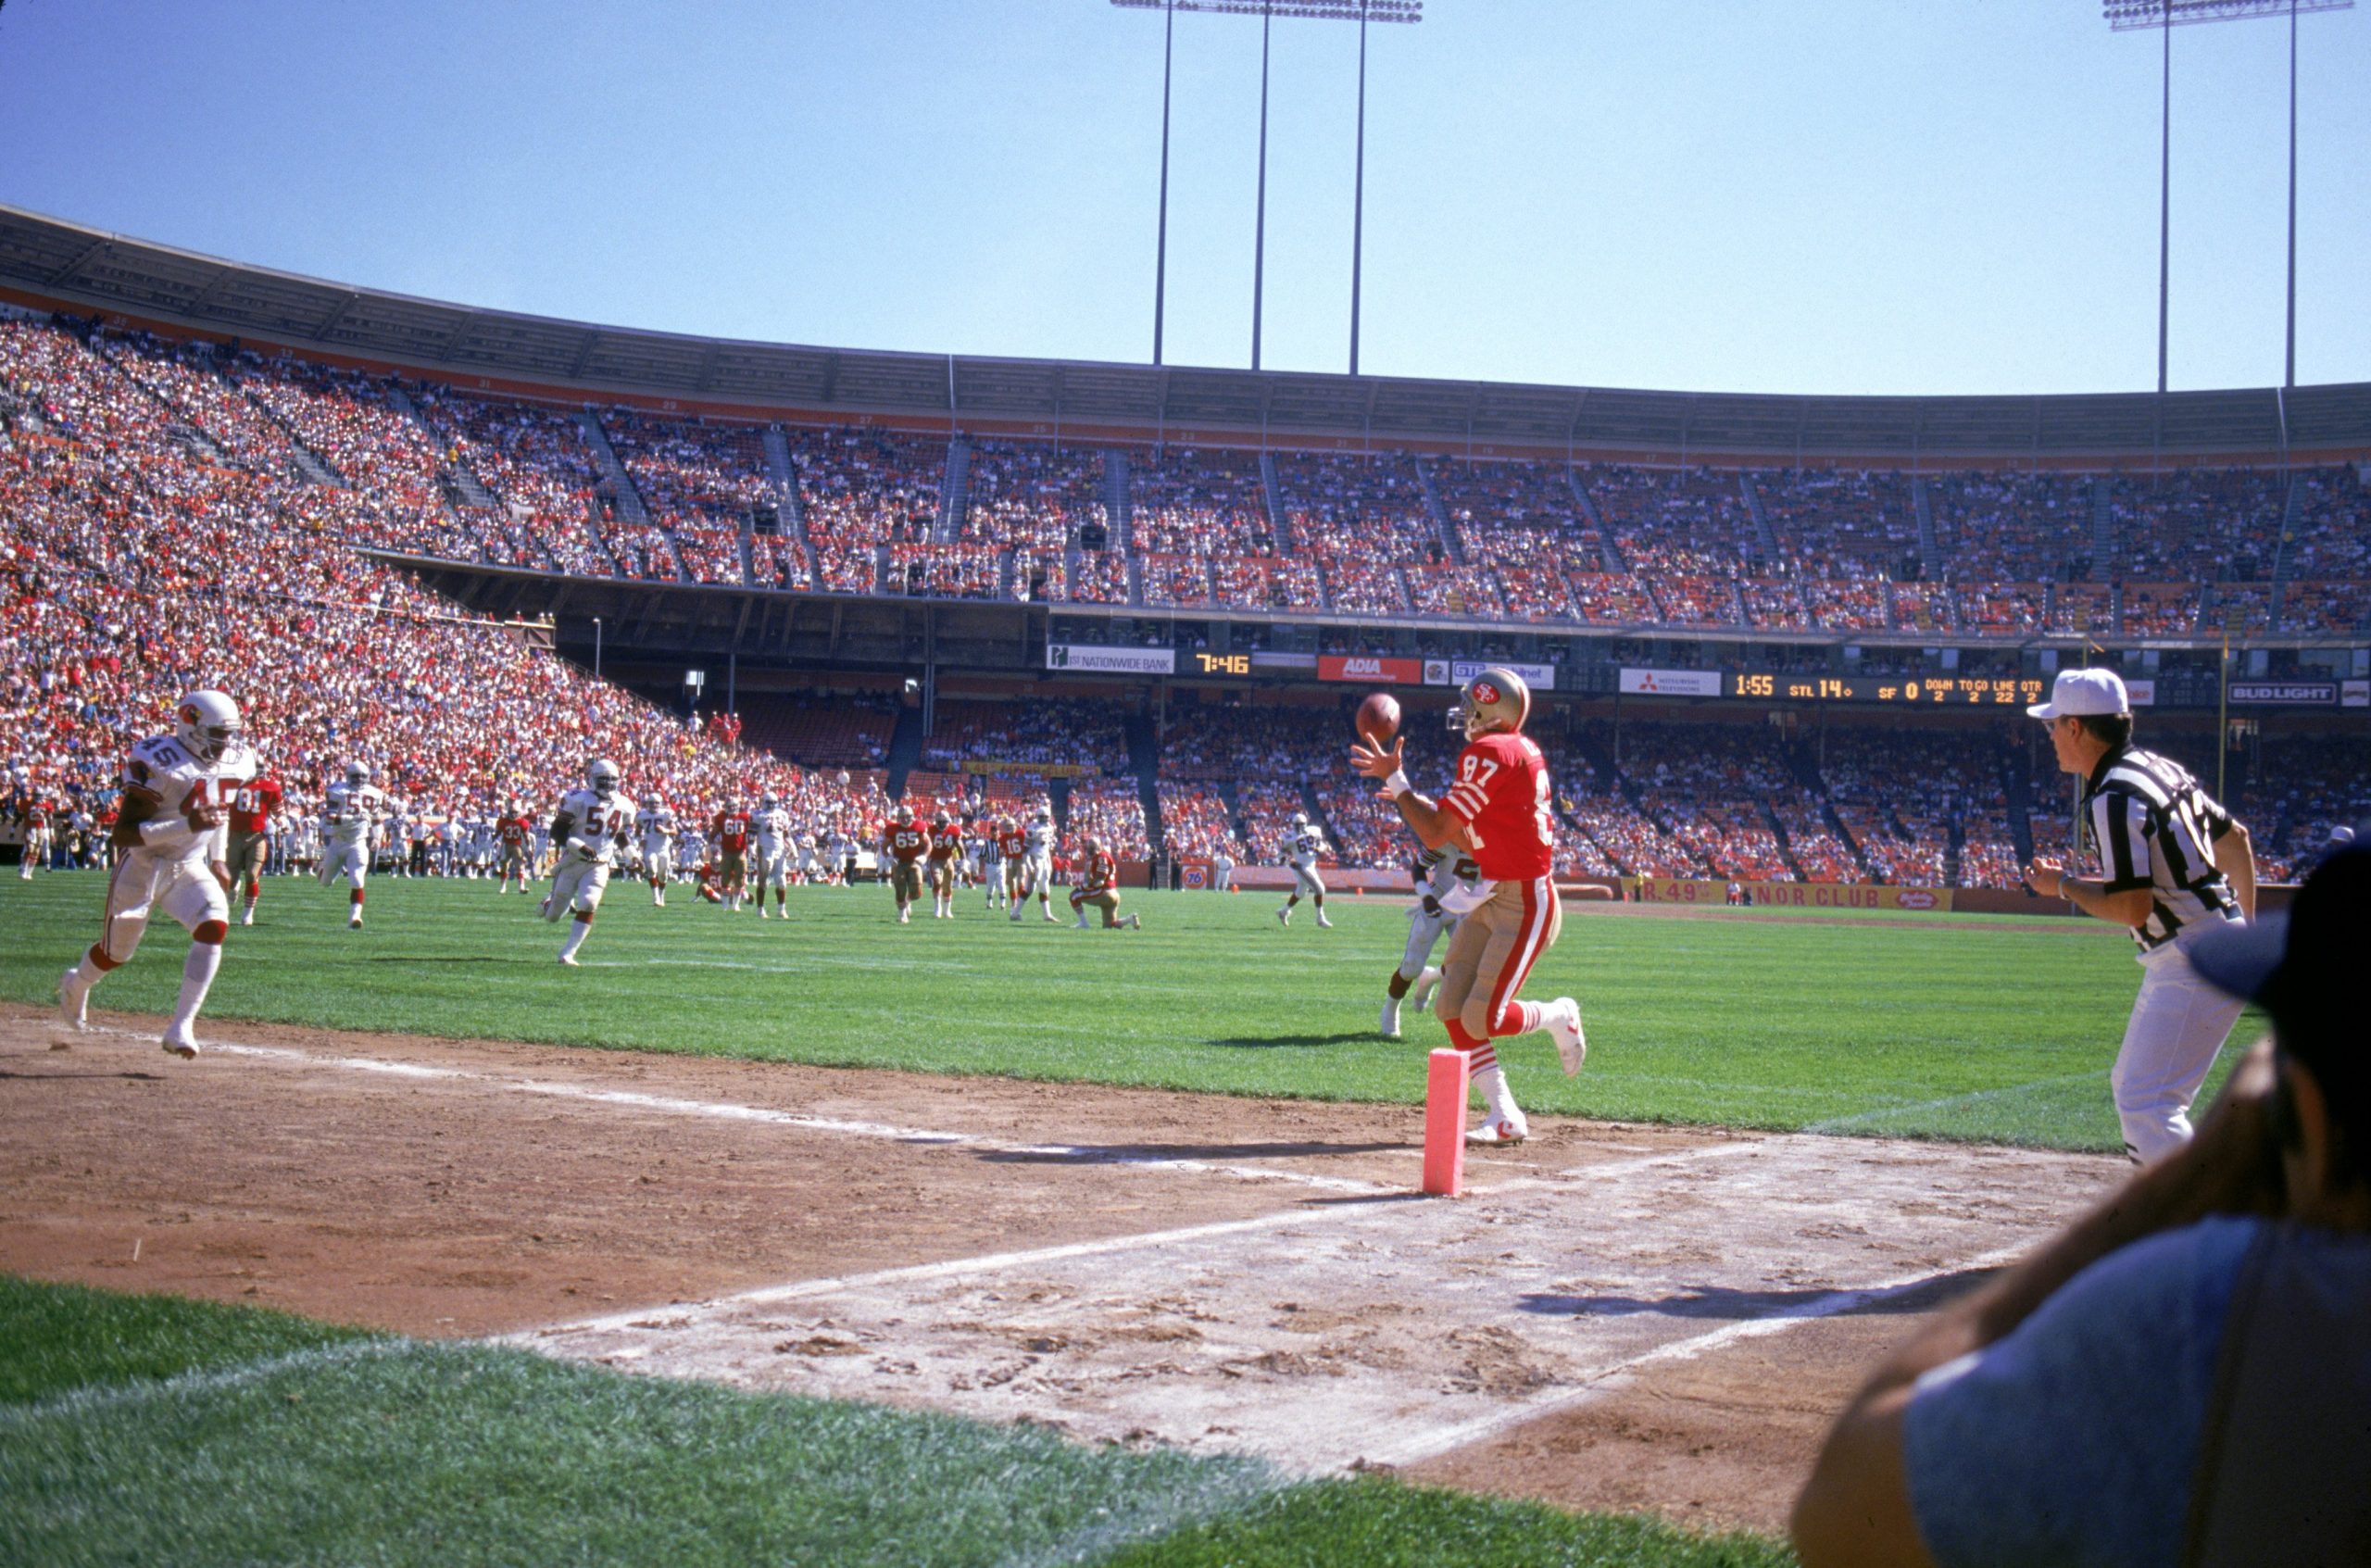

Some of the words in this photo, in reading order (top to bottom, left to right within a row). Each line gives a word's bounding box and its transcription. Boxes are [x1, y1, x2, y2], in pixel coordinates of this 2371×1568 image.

[662, 400, 677, 409] 29
[1082, 656, 1142, 669] NATIONWIDE
[1143, 659, 1170, 670] BANK
[1196, 653, 1249, 674] 7:46
[1343, 657, 1380, 673] ADIA
[1737, 674, 1774, 696] 1:55
[1788, 685, 1814, 697] STL
[1819, 679, 1842, 698] 14
[1878, 686, 1898, 700] SF
[1905, 681, 1918, 700] 0
[1926, 678, 1953, 691] DOWN
[1959, 680, 1973, 691] TO
[1975, 681, 1988, 691] GO
[1993, 681, 2016, 692] LINE
[2021, 681, 2043, 692] QTR
[2233, 687, 2273, 699] BUD
[2274, 687, 2331, 699] LIGHT
[1934, 691, 1944, 702] 2
[1969, 691, 1979, 703] 2
[1995, 692, 2015, 703] 22
[2026, 692, 2037, 703] 2
[1462, 755, 1499, 788] 87
[237, 788, 261, 813] 81
[346, 793, 374, 815] 59
[584, 806, 622, 838] 54
[724, 819, 745, 834] 60
[505, 825, 521, 839] 33
[895, 832, 920, 848] 65
[934, 834, 953, 848] 64
[1006, 839, 1022, 855] 16
[1187, 872, 1202, 884] 76
[1816, 887, 1878, 908] CLUB
